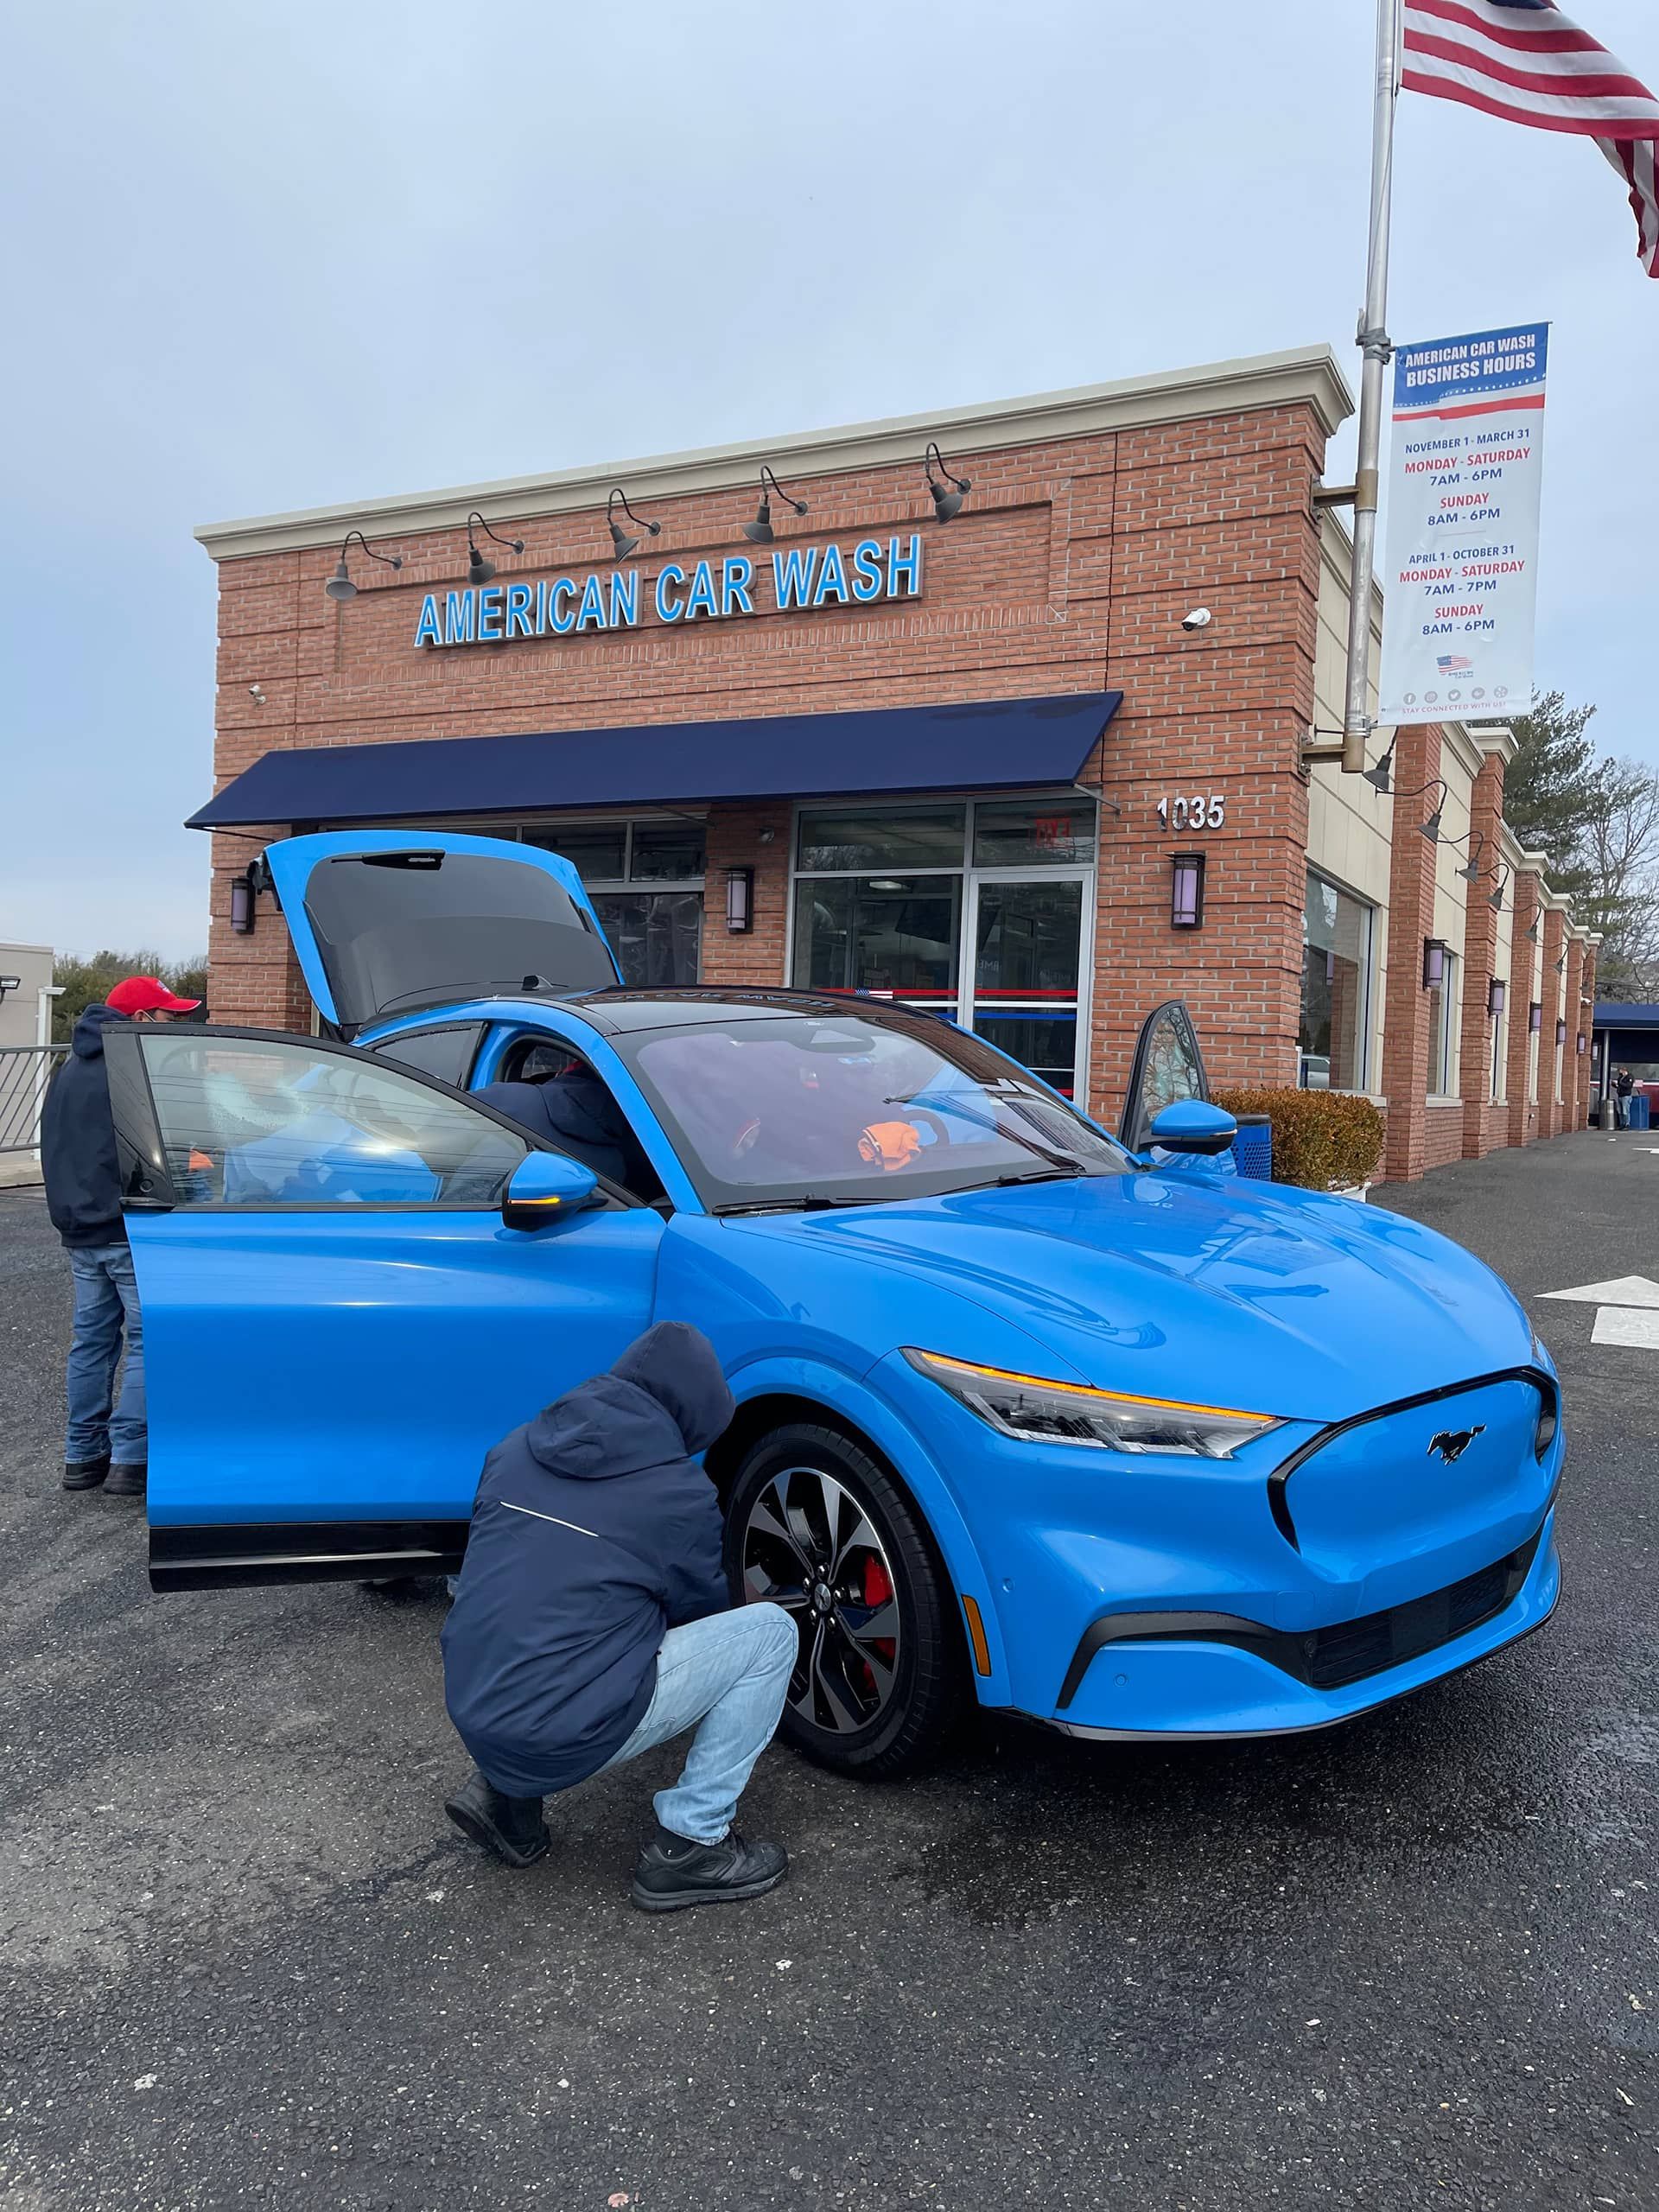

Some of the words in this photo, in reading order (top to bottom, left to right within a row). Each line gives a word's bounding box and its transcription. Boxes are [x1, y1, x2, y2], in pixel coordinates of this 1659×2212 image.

[1406, 345, 1468, 367] AMERICAN
[1471, 340, 1496, 357] CAR
[1497, 334, 1535, 351] WASH
[1407, 360, 1480, 387] BUSINESS
[1484, 353, 1535, 375] HOURS
[1405, 438, 1461, 454] NOVEMBER
[1464, 436, 1469, 446] 1
[1477, 431, 1514, 445] MARCH
[1517, 429, 1530, 439] 31
[1405, 457, 1458, 474] MONDAY
[1467, 448, 1531, 466] SATURDAY
[1430, 473, 1460, 486] 7AM
[1471, 467, 1503, 481] 6PM
[1440, 493, 1490, 509] SUNDAY
[1427, 512, 1458, 526] 8AM
[1470, 508, 1500, 521] 6PM
[1408, 552, 1438, 564] APRIL
[1440, 552, 1446, 561] 1
[1452, 546, 1499, 561] OCTOBER
[1501, 544, 1515, 555] 31
[1399, 567, 1452, 583] MONDAY
[1461, 560, 1525, 577] SATURDAY
[414, 569, 641, 648] AMERICAN
[654, 556, 755, 623] CAR
[772, 533, 924, 609] WASH
[1424, 583, 1455, 596] 7AM
[1467, 580, 1497, 593] 7PM
[1434, 604, 1484, 619] SUNDAY
[1422, 623, 1452, 635] 8AM
[1465, 619, 1495, 632] 6PM
[1421, 703, 1469, 713] CONNECTED
[1471, 702, 1490, 710] WITH
[1157, 795, 1225, 831] 1035
